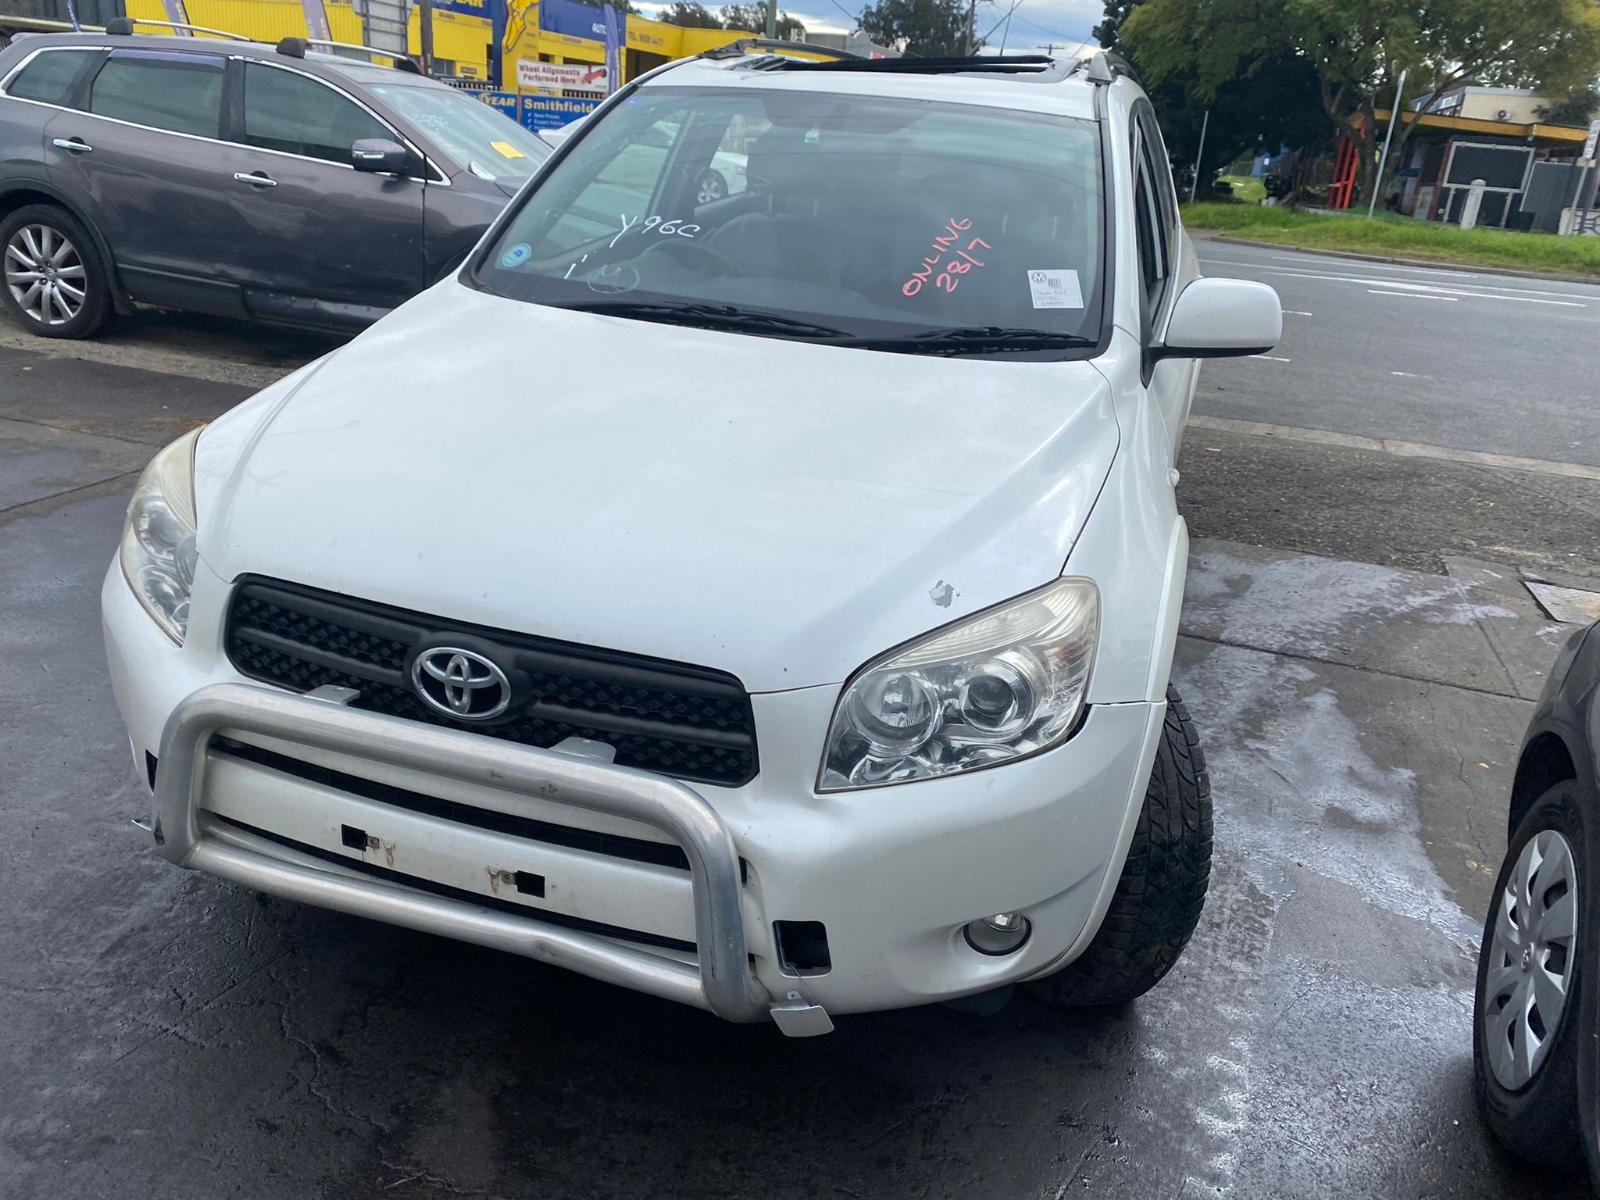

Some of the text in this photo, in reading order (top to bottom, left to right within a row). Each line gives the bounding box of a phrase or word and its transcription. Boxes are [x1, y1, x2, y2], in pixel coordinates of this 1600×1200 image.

[519, 64, 580, 76] Wheel Alignments
[523, 73, 576, 84] Performed Here
[524, 98, 594, 113] Smithfield
